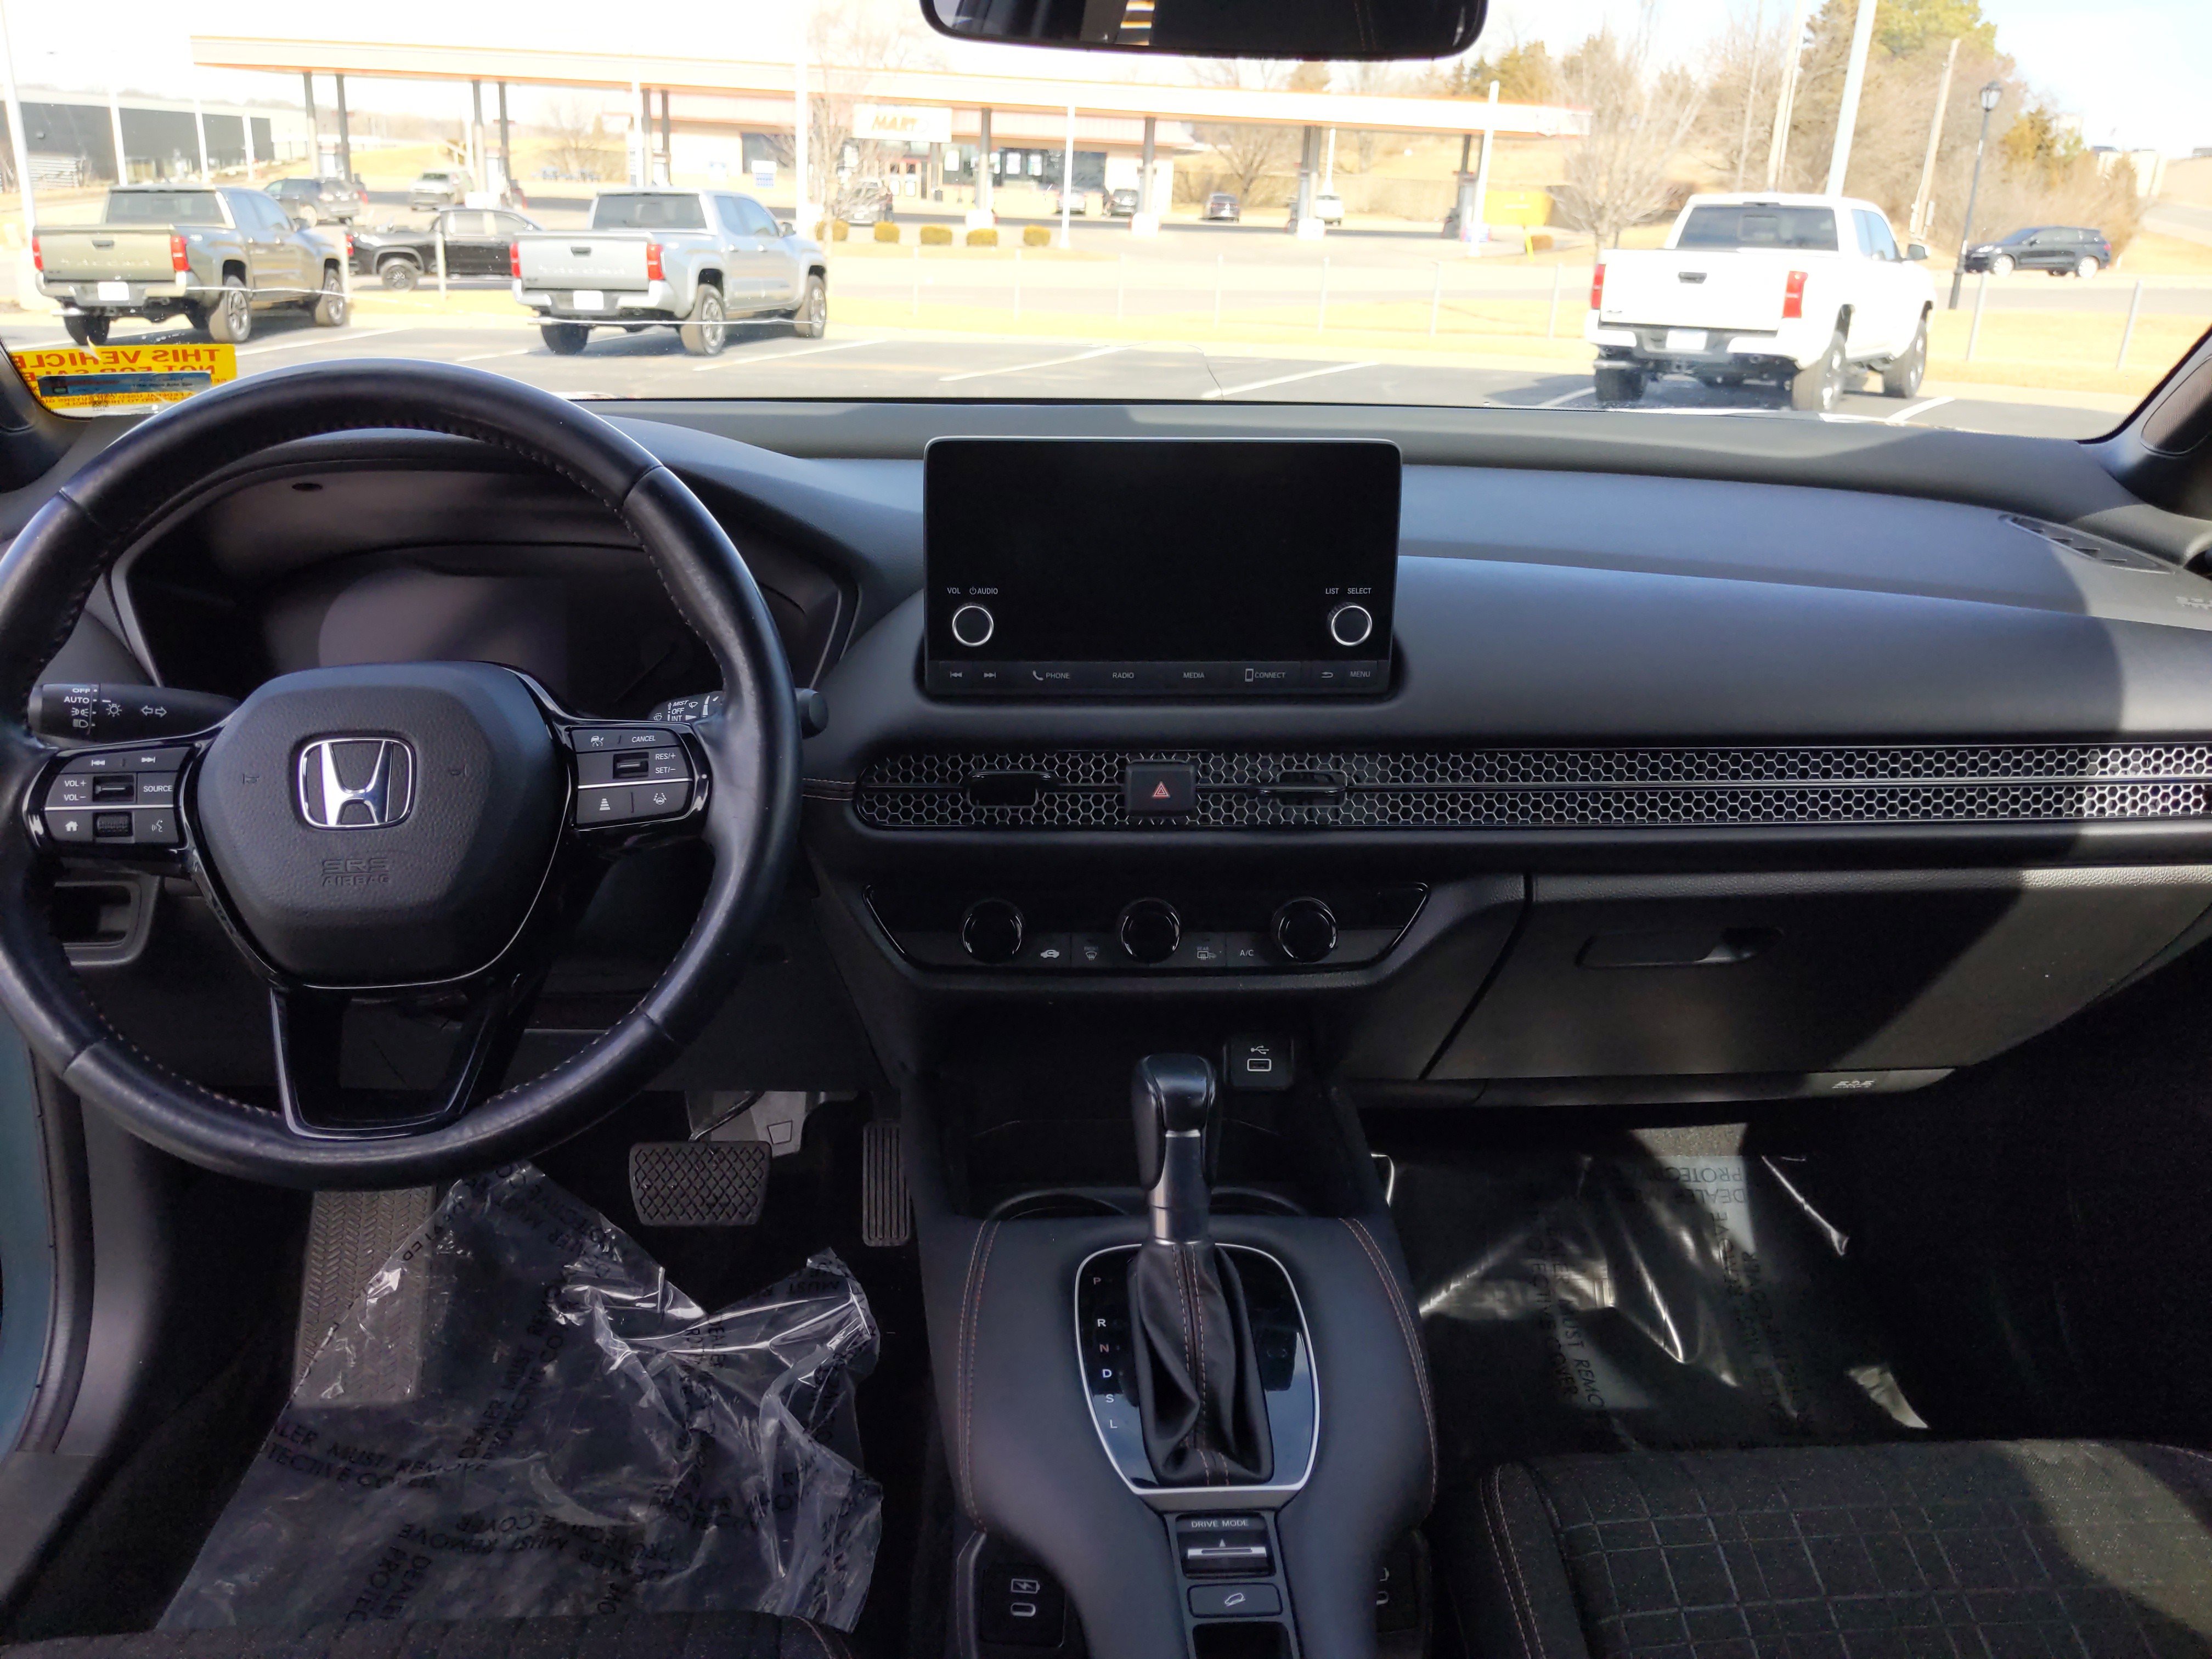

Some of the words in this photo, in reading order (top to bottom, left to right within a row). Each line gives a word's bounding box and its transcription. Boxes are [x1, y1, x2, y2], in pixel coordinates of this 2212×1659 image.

[671, 707, 685, 715] OFF
[655, 753, 676, 761] RES/+
[321, 856, 390, 873] SRS
[1093, 1277, 1101, 1285] P
[1097, 1318, 1107, 1327] R
[1099, 1344, 1109, 1353] N
[1102, 1368, 1112, 1378] D
[1105, 1393, 1114, 1403] S
[1109, 1419, 1118, 1429] L
[1190, 1520, 1218, 1528] DRIVE
[1221, 1519, 1249, 1527] MODE
